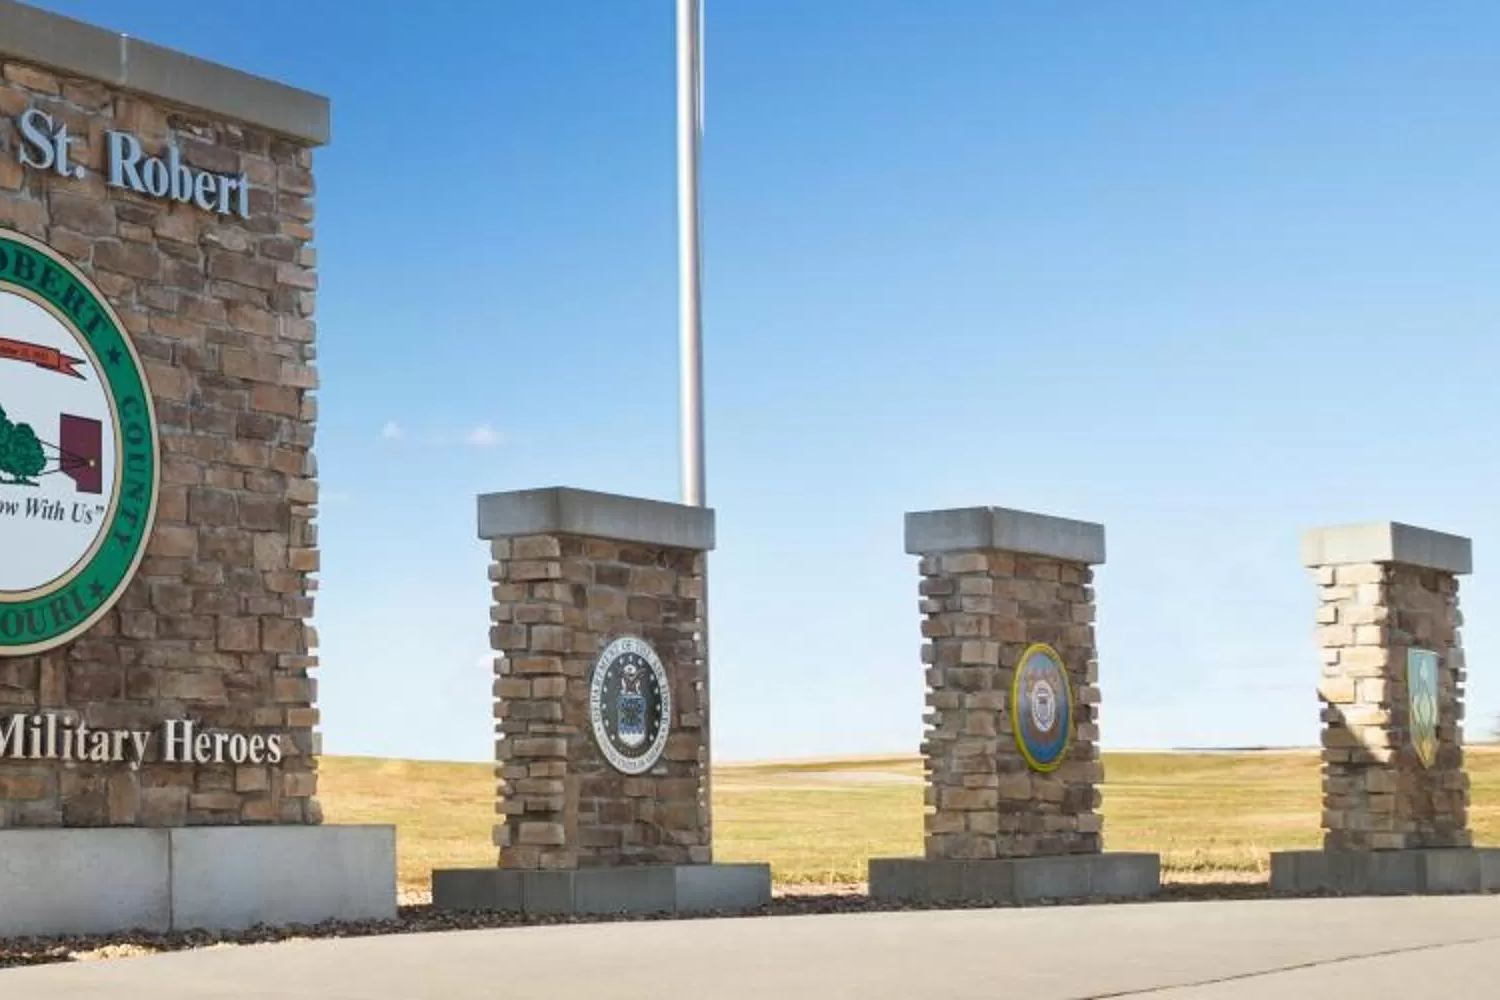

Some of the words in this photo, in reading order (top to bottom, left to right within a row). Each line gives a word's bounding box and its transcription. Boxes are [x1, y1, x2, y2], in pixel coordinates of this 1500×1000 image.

[16, 109, 89, 179] St.
[104, 129, 252, 219] Robert
[24, 500, 65, 521] With
[111, 394, 148, 556] COUNTY
[163, 719, 283, 764] Heroes
